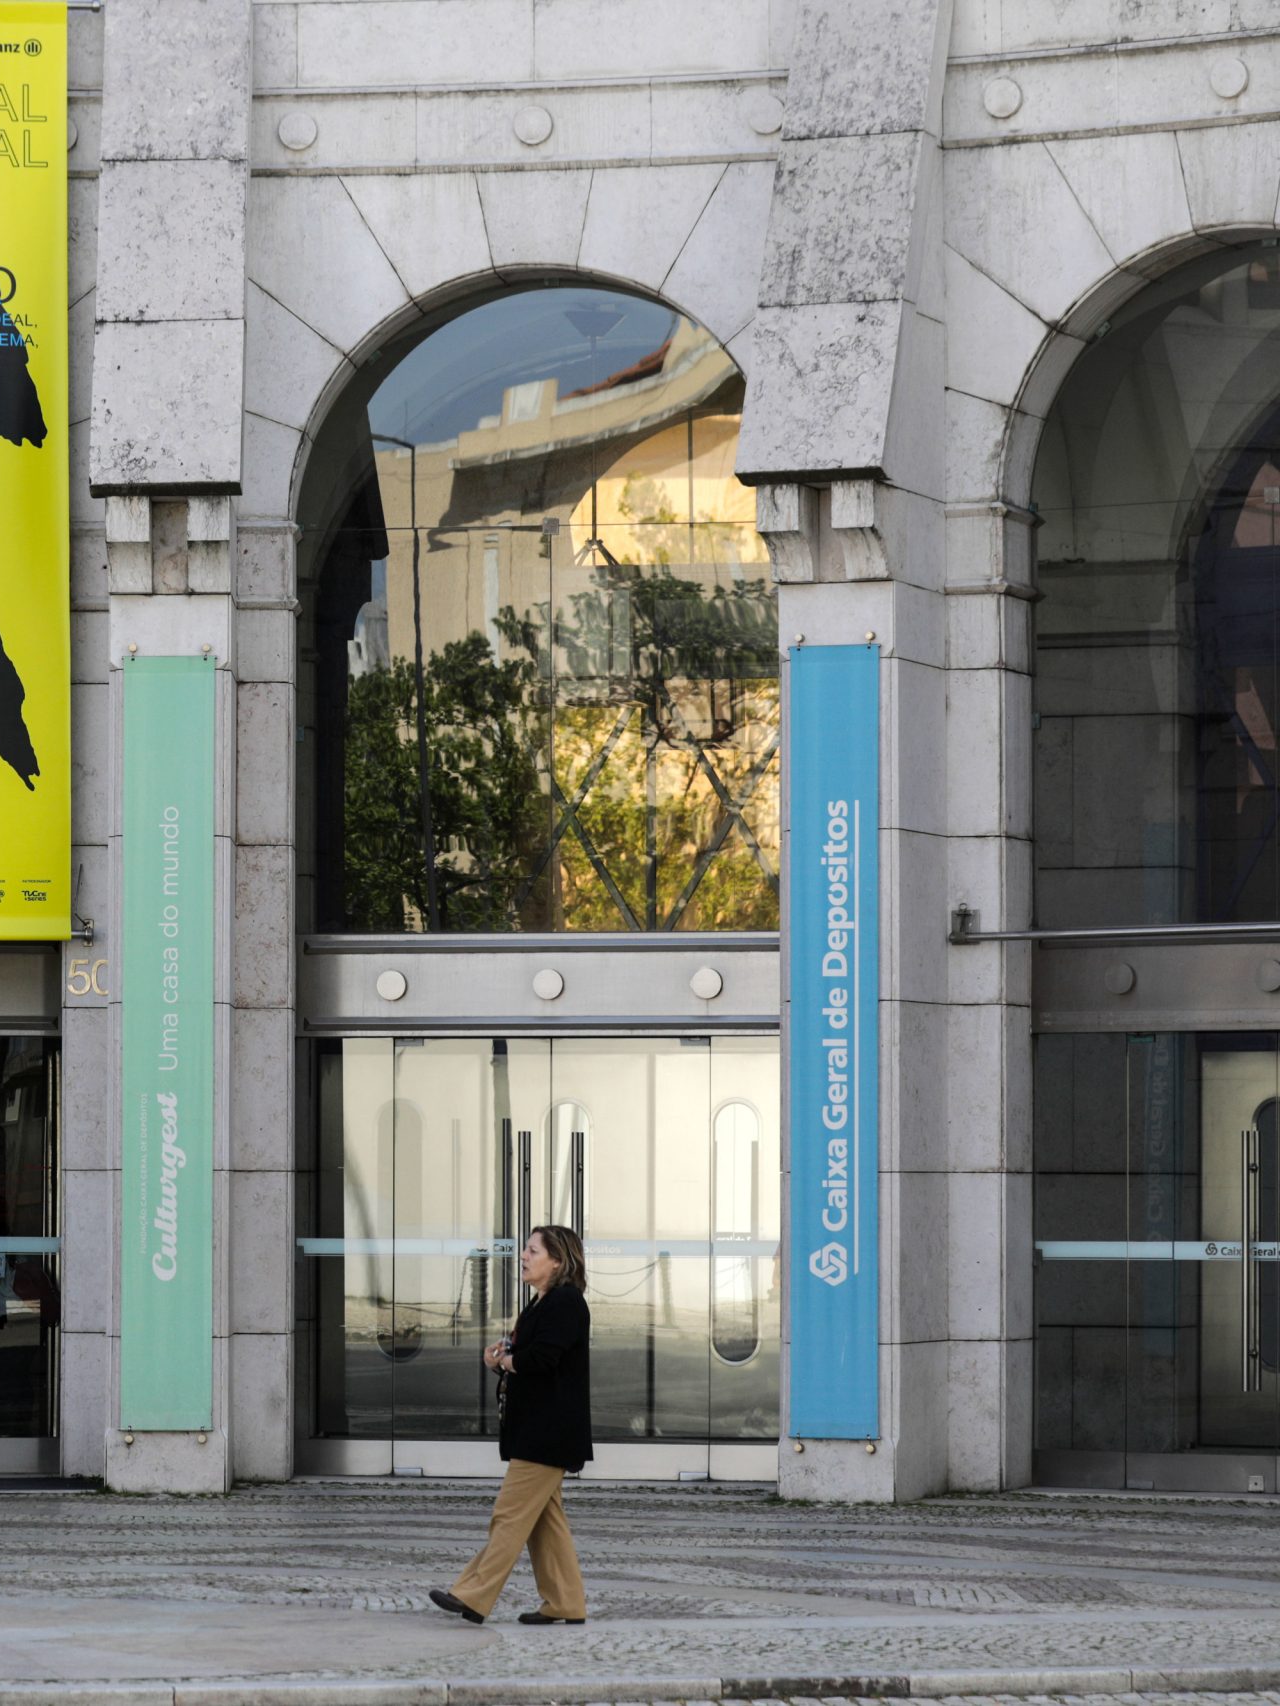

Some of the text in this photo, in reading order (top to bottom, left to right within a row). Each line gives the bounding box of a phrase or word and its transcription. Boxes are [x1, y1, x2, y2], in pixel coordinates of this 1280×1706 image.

[158, 805, 180, 1071] Uma casa do mundo
[822, 987, 849, 1029] de
[822, 1040, 849, 1130] Geral
[152, 1091, 188, 1282] Culturgest
[822, 1138, 849, 1233] Caixa
[493, 1243, 514, 1253] Caix
[1220, 1246, 1242, 1256] Caix
